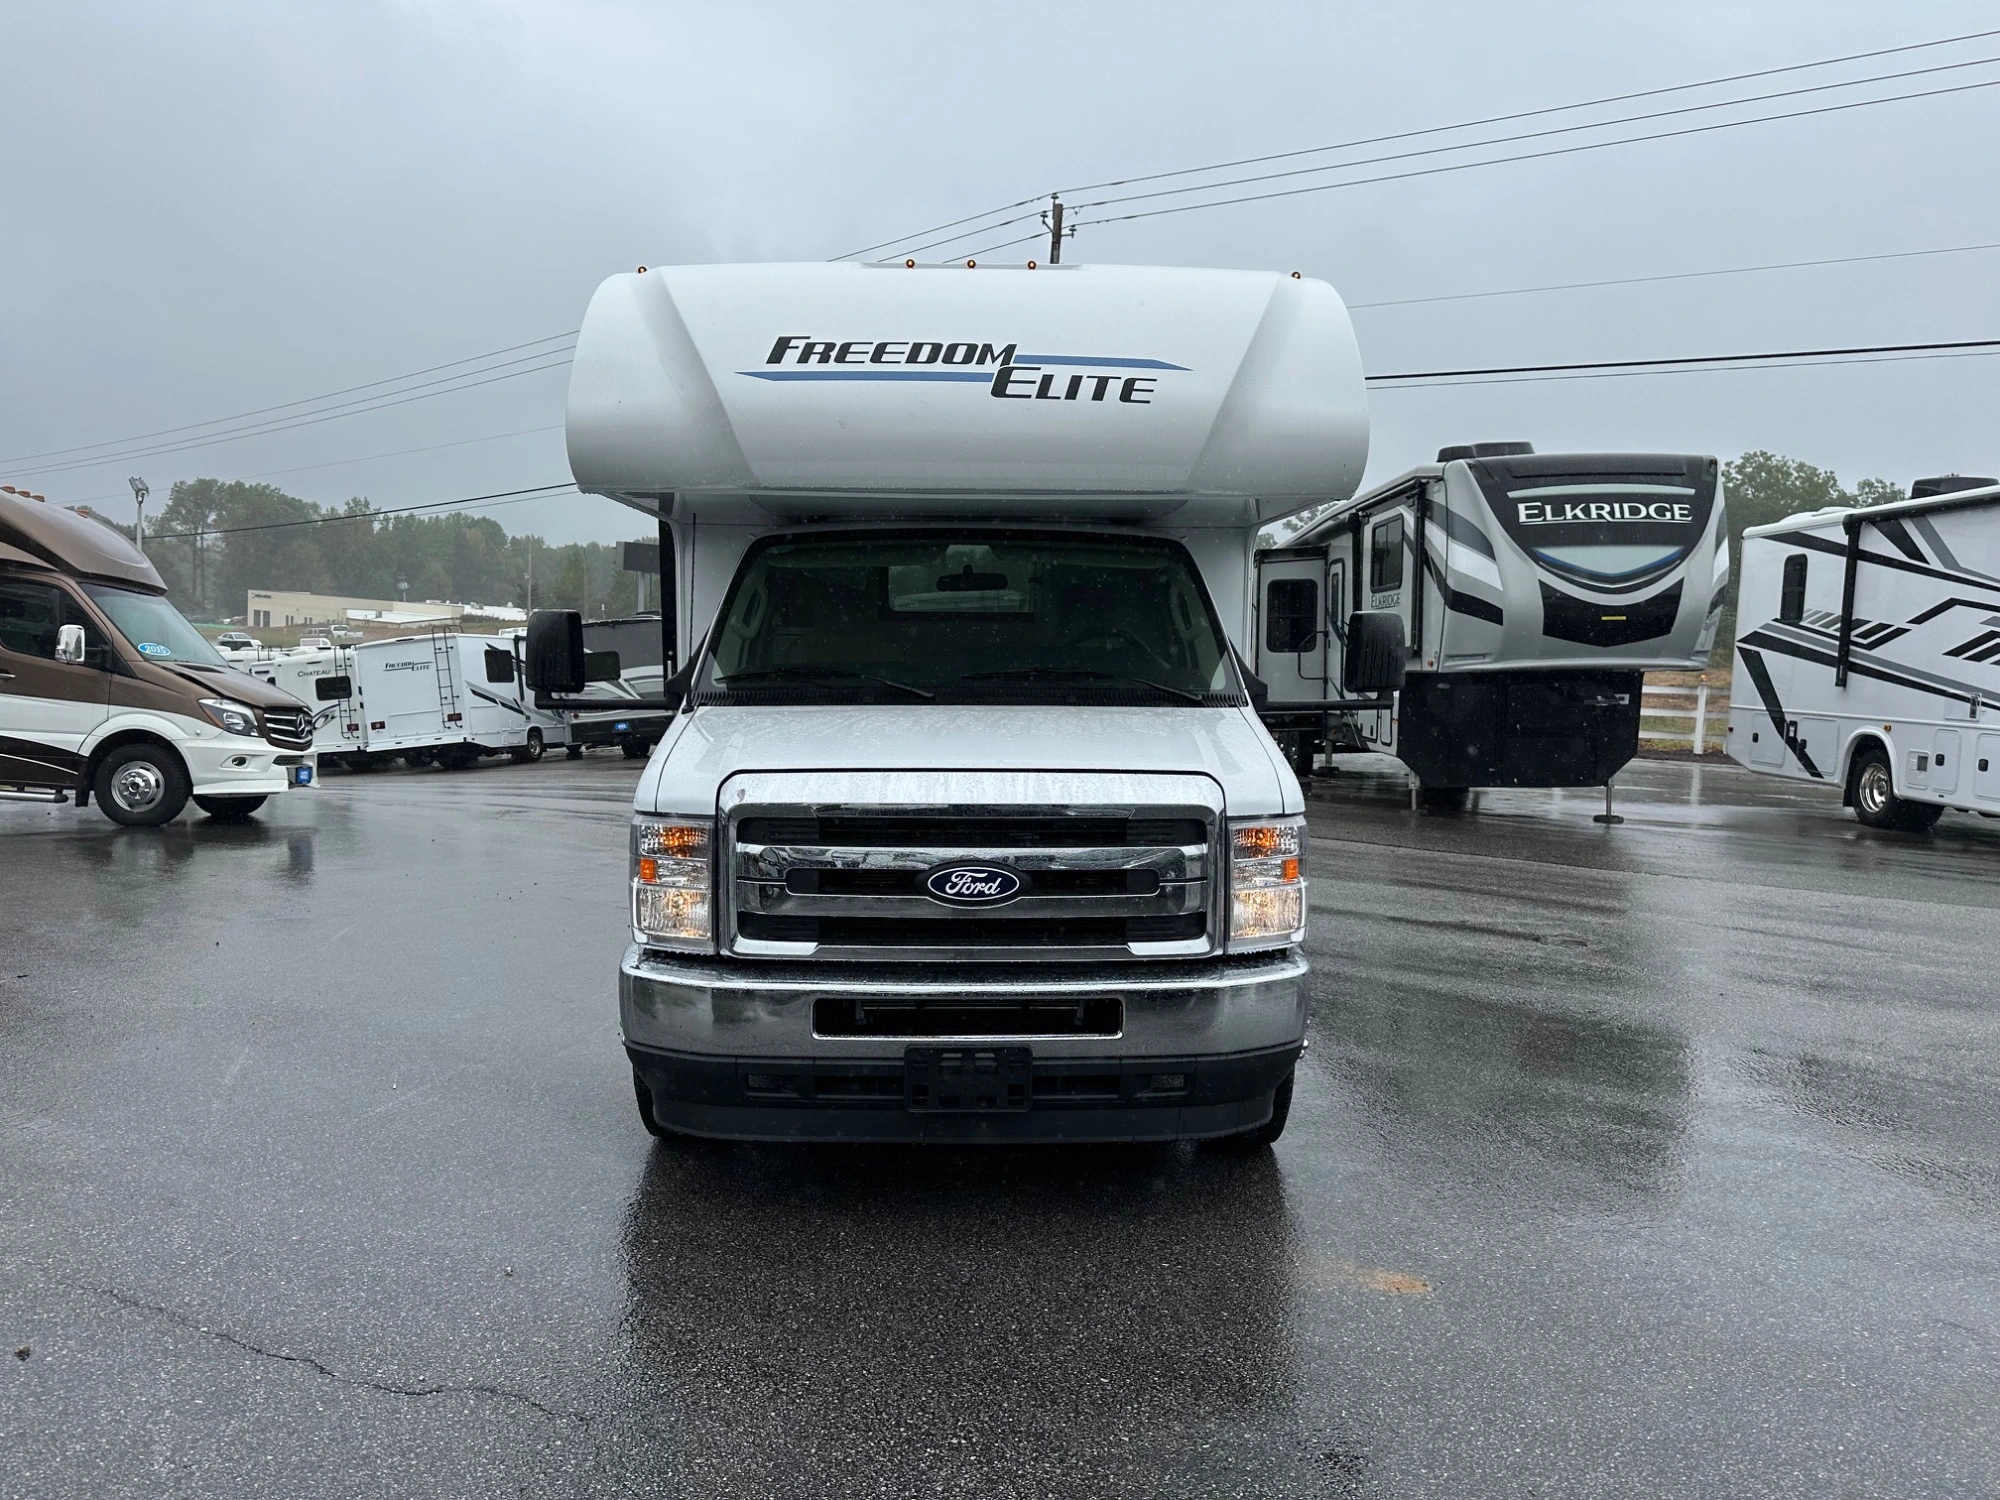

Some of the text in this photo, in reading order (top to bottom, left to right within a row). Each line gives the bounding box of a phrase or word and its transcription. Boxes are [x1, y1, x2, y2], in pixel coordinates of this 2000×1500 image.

[765, 335, 1017, 366] FREEDOM
[991, 366, 1158, 404] ELITE
[1517, 502, 1693, 523] ELKRIDGE
[297, 668, 331, 678] CHATEAU
[945, 871, 1002, 895] Ford
